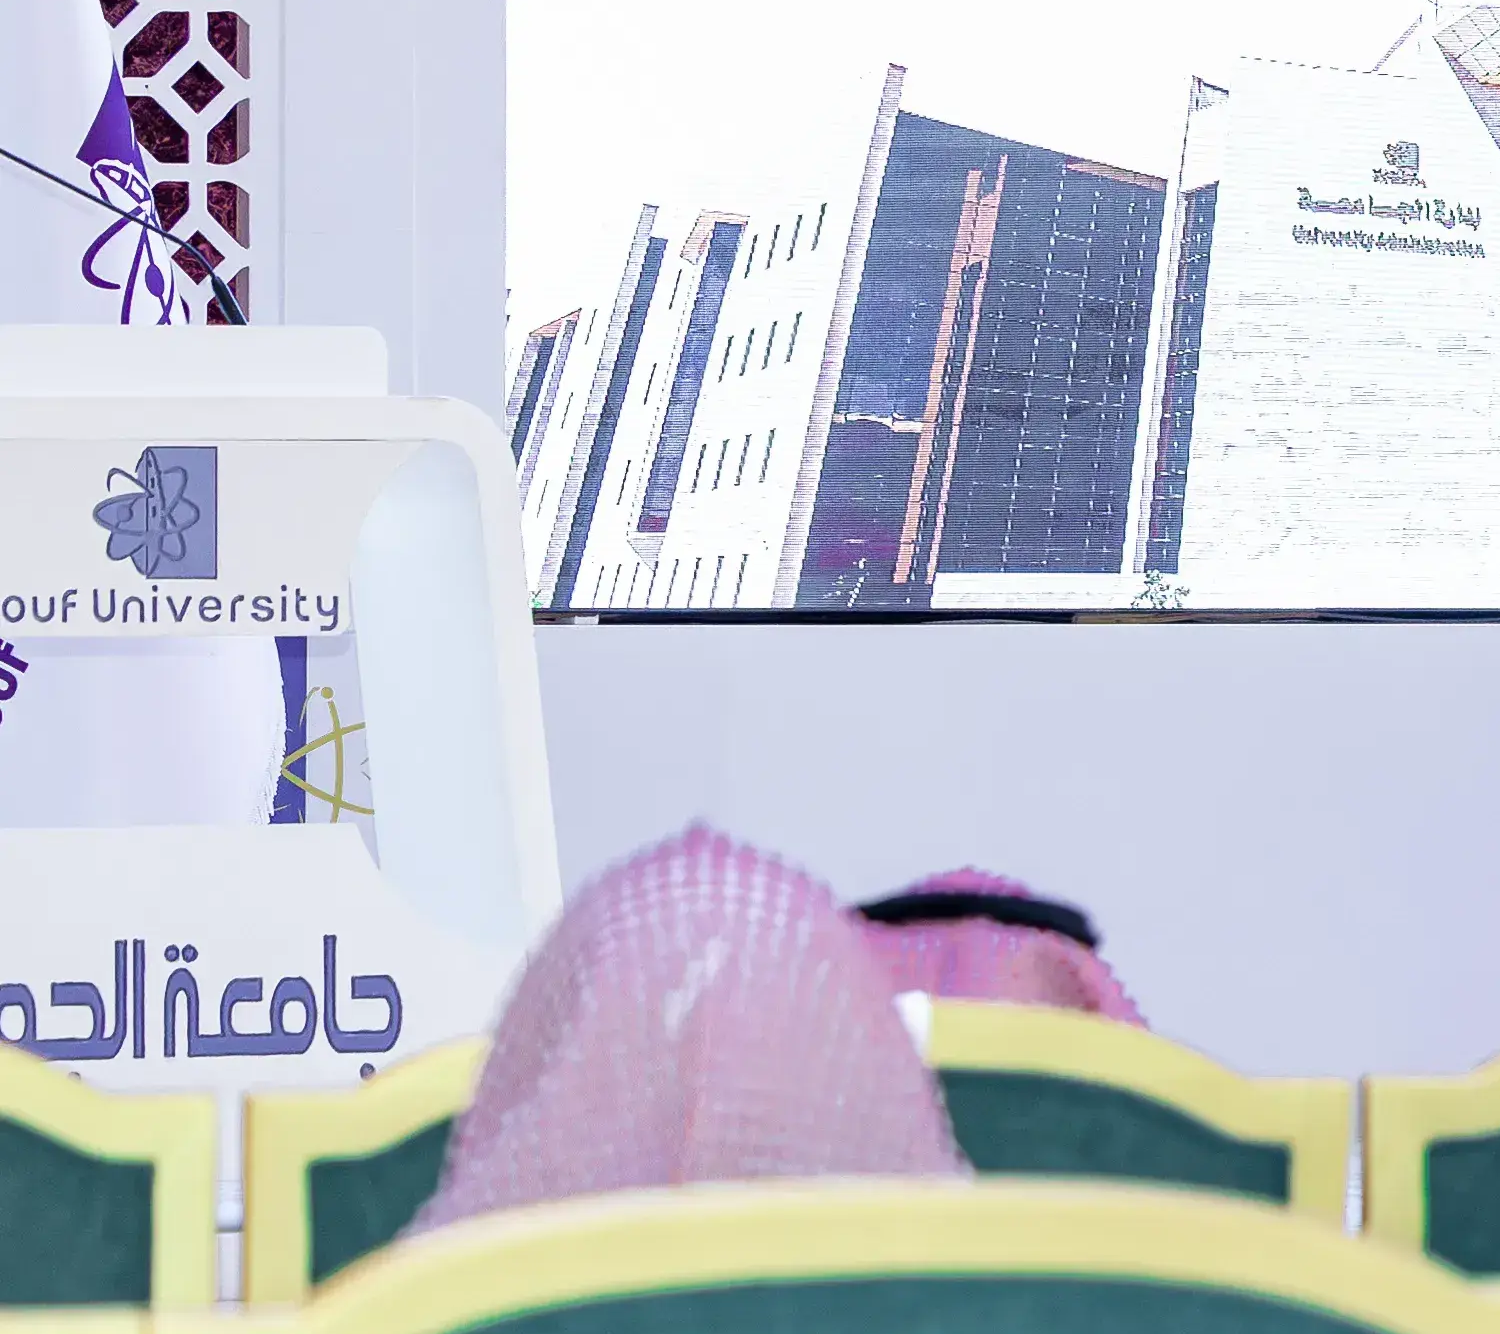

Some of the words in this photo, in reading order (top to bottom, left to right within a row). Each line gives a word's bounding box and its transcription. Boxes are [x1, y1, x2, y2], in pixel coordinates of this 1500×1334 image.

[1, 588, 78, 624] ouf
[92, 584, 340, 632] University
[163, 933, 403, 1081] جامعة
